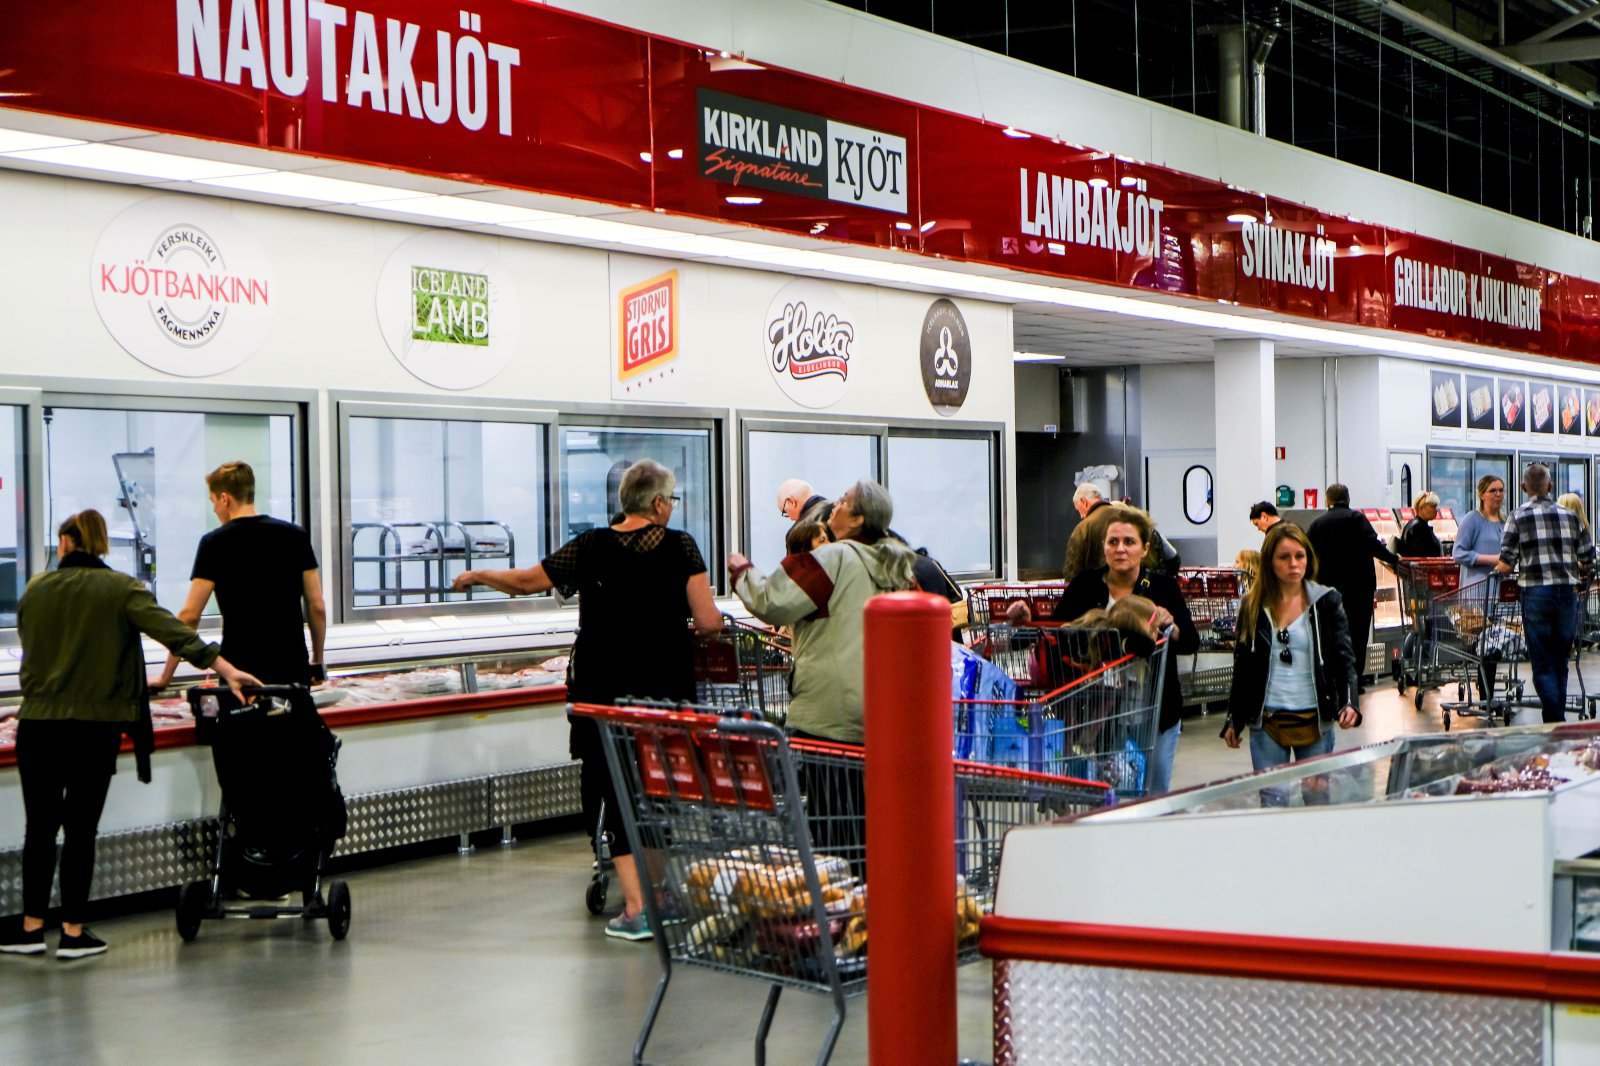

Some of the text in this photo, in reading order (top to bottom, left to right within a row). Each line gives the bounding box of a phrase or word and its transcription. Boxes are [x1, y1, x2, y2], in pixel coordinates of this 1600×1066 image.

[176, 0, 520, 136] NAUTAKJÖT
[704, 107, 902, 201] KIRKLAND KJÖT
[705, 148, 823, 187] Signature
[1020, 167, 1164, 259] LAMBAKJÖT
[157, 231, 217, 263] FERSKLEIKI
[101, 259, 268, 307] KJÖTBANKINN
[412, 268, 488, 300] ICELAND
[1394, 255, 1541, 332] GRILLAÐUR KJÚKLINGUR
[157, 306, 220, 341] FAGMENNSKA
[412, 294, 488, 339] LAMB
